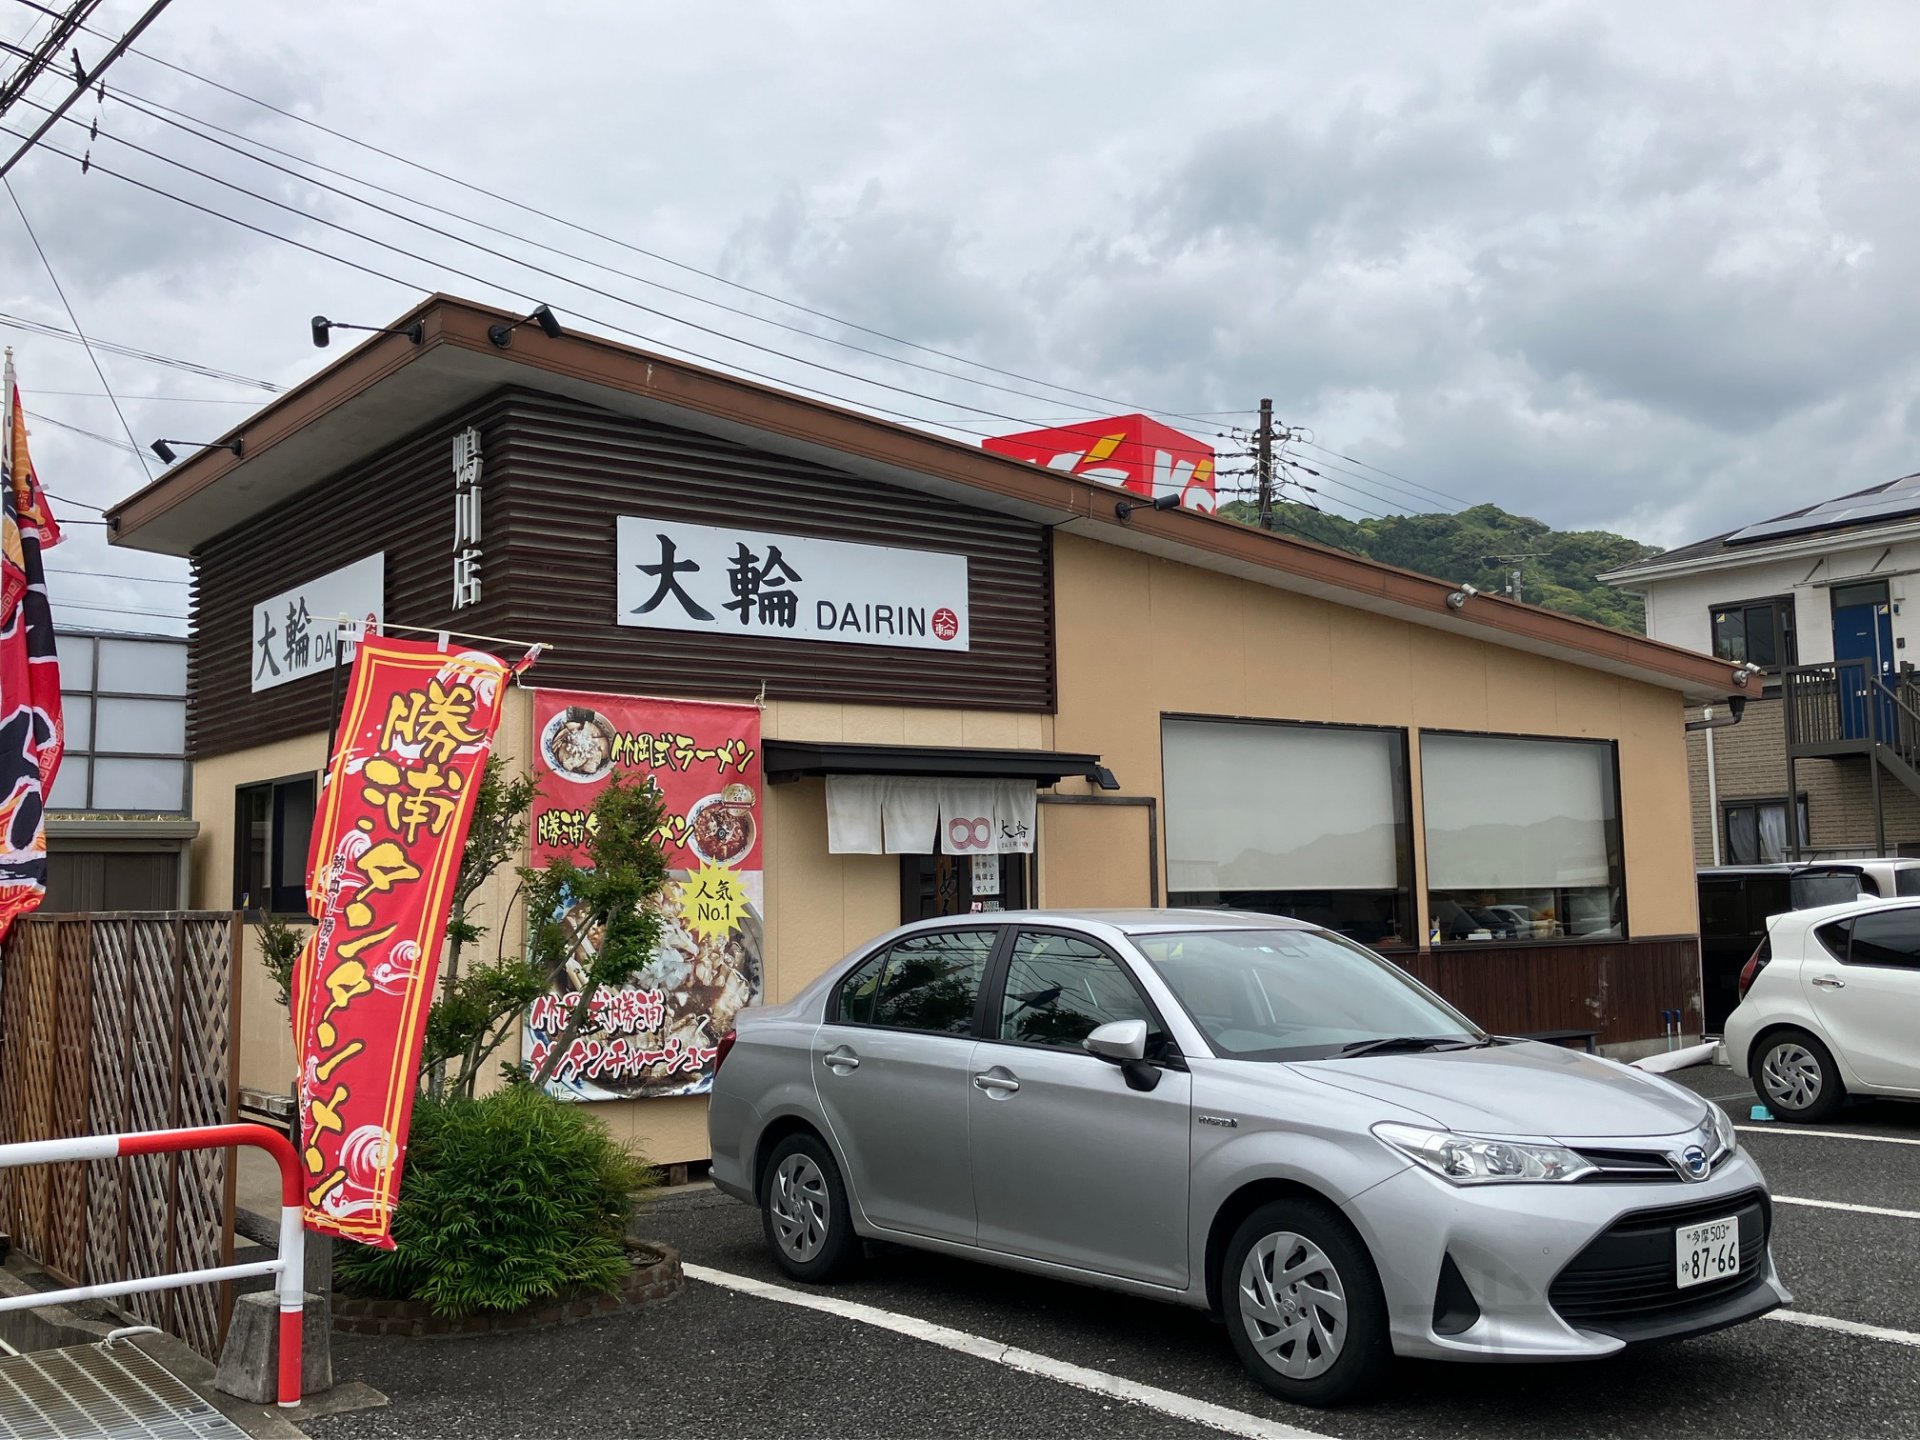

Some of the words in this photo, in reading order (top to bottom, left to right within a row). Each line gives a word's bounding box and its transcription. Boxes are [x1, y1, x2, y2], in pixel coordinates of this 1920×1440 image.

[452, 426, 483, 611] 鴨川店
[630, 534, 803, 628] 大輪
[816, 600, 926, 637] DAIRIN
[255, 596, 312, 681] 大輪
[610, 731, 755, 774] 竹岡式ラーメン
[695, 880, 733, 902] 人気
[697, 903, 731, 922] No.1
[305, 680, 486, 1207] 勝浦タンタンメン
[1691, 1241, 1736, 1280] 87-66
